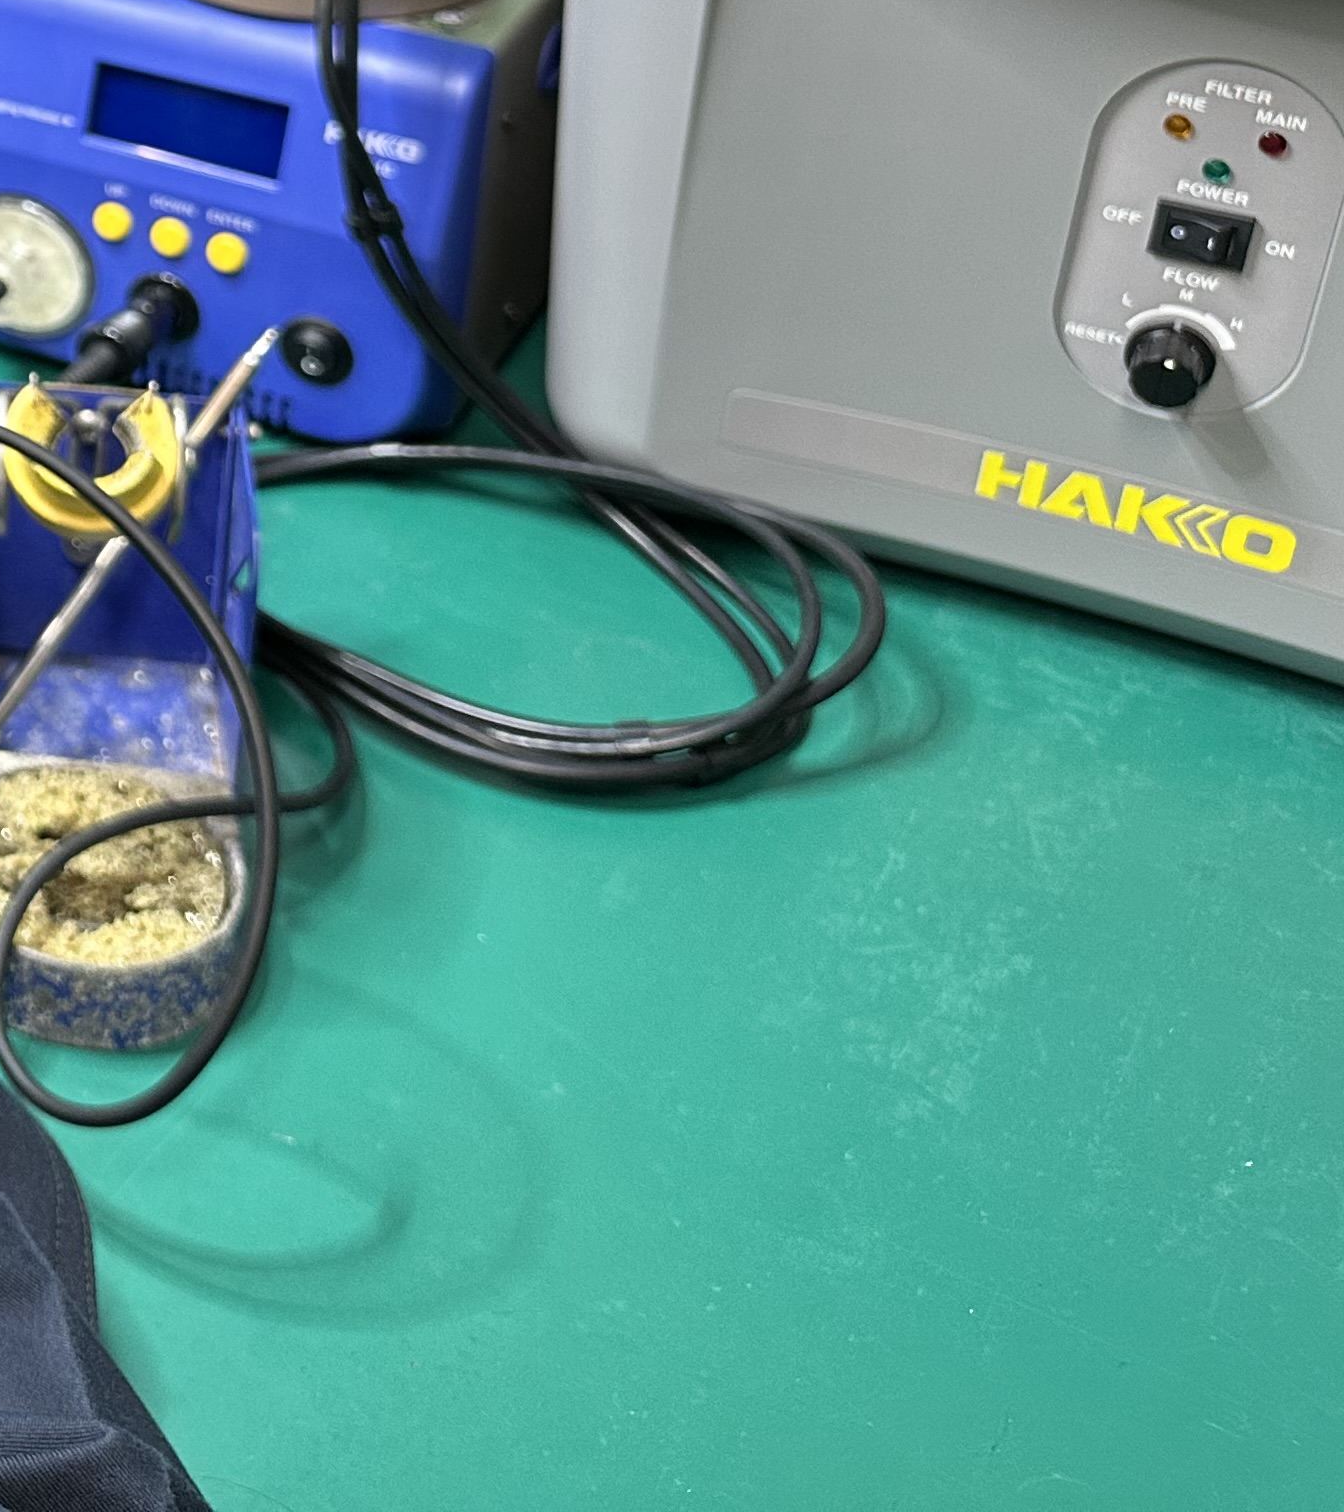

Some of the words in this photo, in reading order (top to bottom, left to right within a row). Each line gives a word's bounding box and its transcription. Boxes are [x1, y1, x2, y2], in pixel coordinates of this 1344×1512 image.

[1166, 91, 1208, 113] PRE
[1205, 78, 1273, 106] FILTER
[1255, 108, 1309, 132] MAIN
[1176, 178, 1250, 208] POWER
[1102, 204, 1144, 226] OFF
[1264, 240, 1296, 260] ON
[1162, 266, 1219, 292] FLOW
[975, 449, 1297, 573] HAKKO
